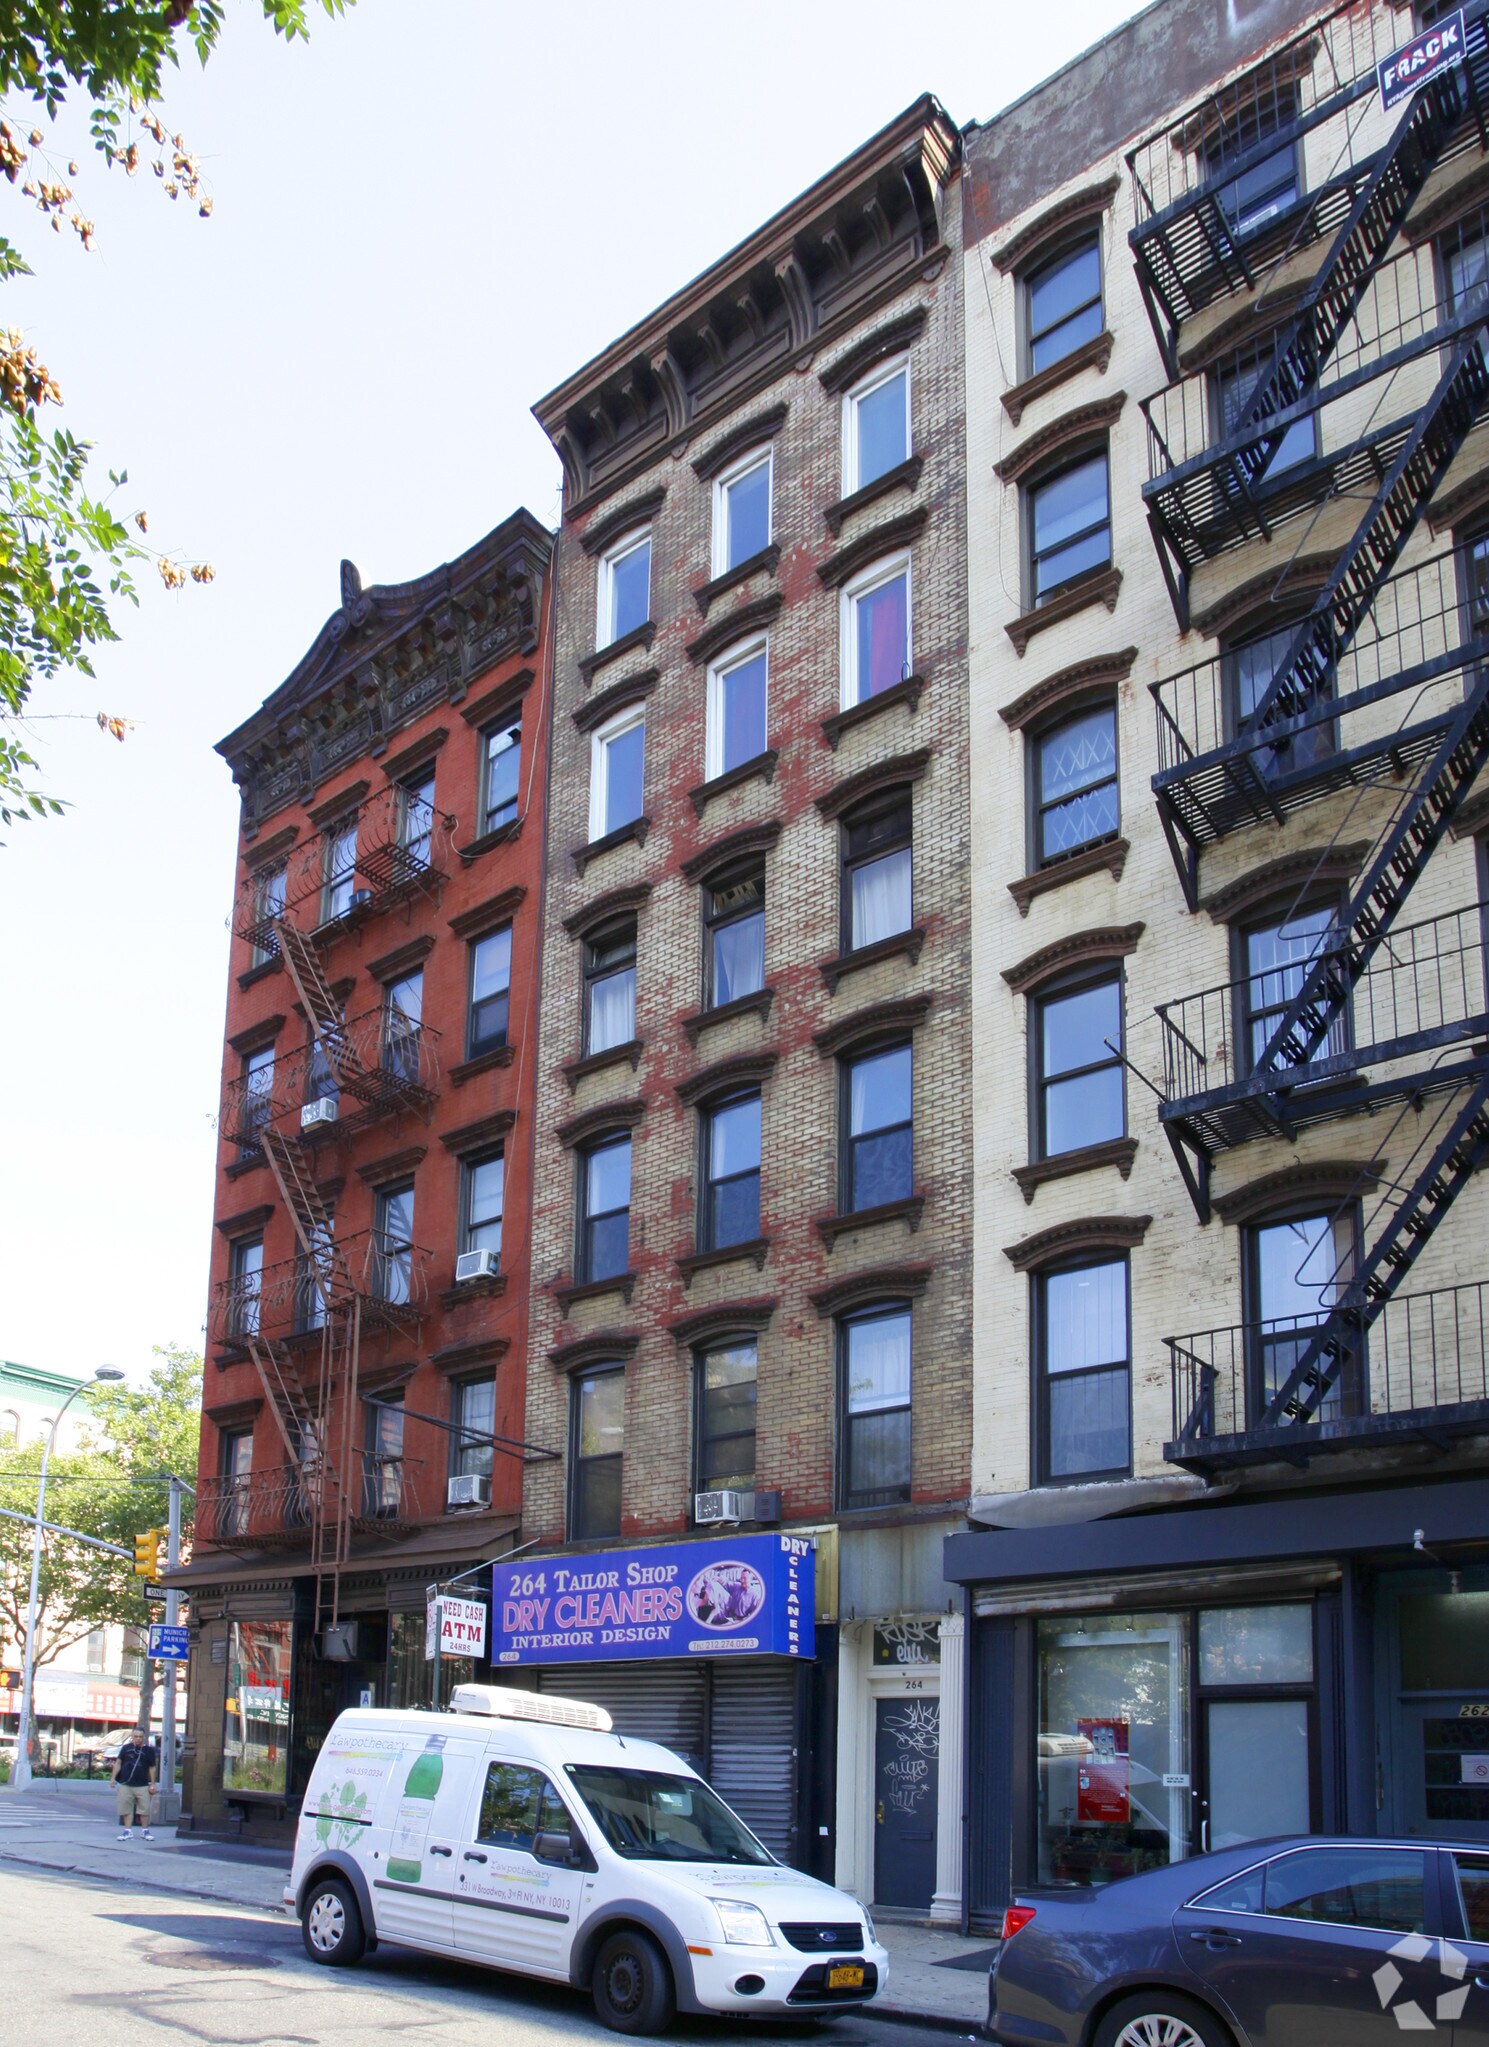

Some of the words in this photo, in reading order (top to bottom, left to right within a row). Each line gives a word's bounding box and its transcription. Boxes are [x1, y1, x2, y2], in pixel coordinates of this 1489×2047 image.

[1383, 23, 1459, 91] FRACK
[780, 1535, 810, 1557] DRY
[150, 1589, 165, 1597] ONE
[510, 1572, 547, 1597] 264
[442, 1600, 462, 1618] NEED
[464, 1604, 485, 1623] CASH
[503, 1598, 551, 1633] DRY
[554, 1586, 684, 1629] CLEANERS
[787, 1556, 801, 1656] CLEANERS
[441, 1620, 482, 1643] ATM
[511, 1629, 594, 1650] INTERIOR
[600, 1626, 672, 1644] DESIGN
[449, 1641, 472, 1653] 24HRS
[502, 1651, 518, 1661] 264
[905, 1680, 923, 1690] 264
[1460, 1705, 1489, 1717] 262
[491, 1861, 552, 1879] rawpothecary
[460, 1880, 471, 1892] 331
[472, 1883, 477, 1892] W
[477, 1885, 507, 1900] Broadway,
[523, 1892, 535, 1905] NY,
[536, 1895, 547, 1905] NY
[549, 1897, 571, 1910] 10013
